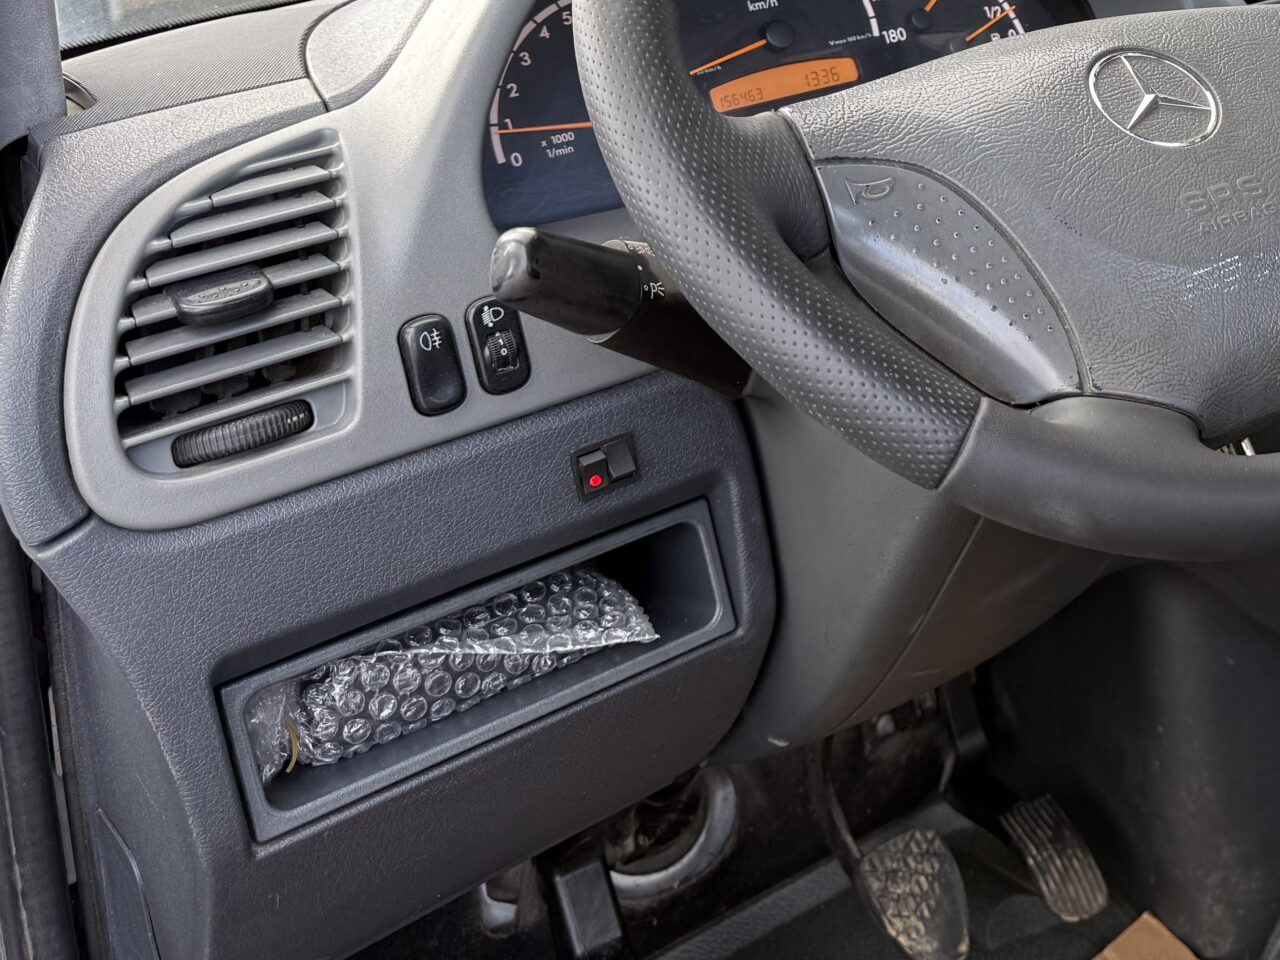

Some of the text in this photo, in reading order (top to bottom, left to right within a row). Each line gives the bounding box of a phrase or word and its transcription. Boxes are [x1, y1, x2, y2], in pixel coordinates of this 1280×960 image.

[562, 11, 573, 26] 5
[983, 5, 1002, 20] 1/2
[539, 25, 551, 39] 4
[882, 27, 907, 44] 180
[520, 51, 532, 66] 3
[506, 82, 520, 98] 2
[720, 88, 764, 108] 156463
[504, 118, 514, 130] 1
[541, 131, 575, 147] x 1000
[546, 144, 575, 159] 1/min
[510, 152, 523, 167] 0
[1180, 175, 1265, 216] SRS
